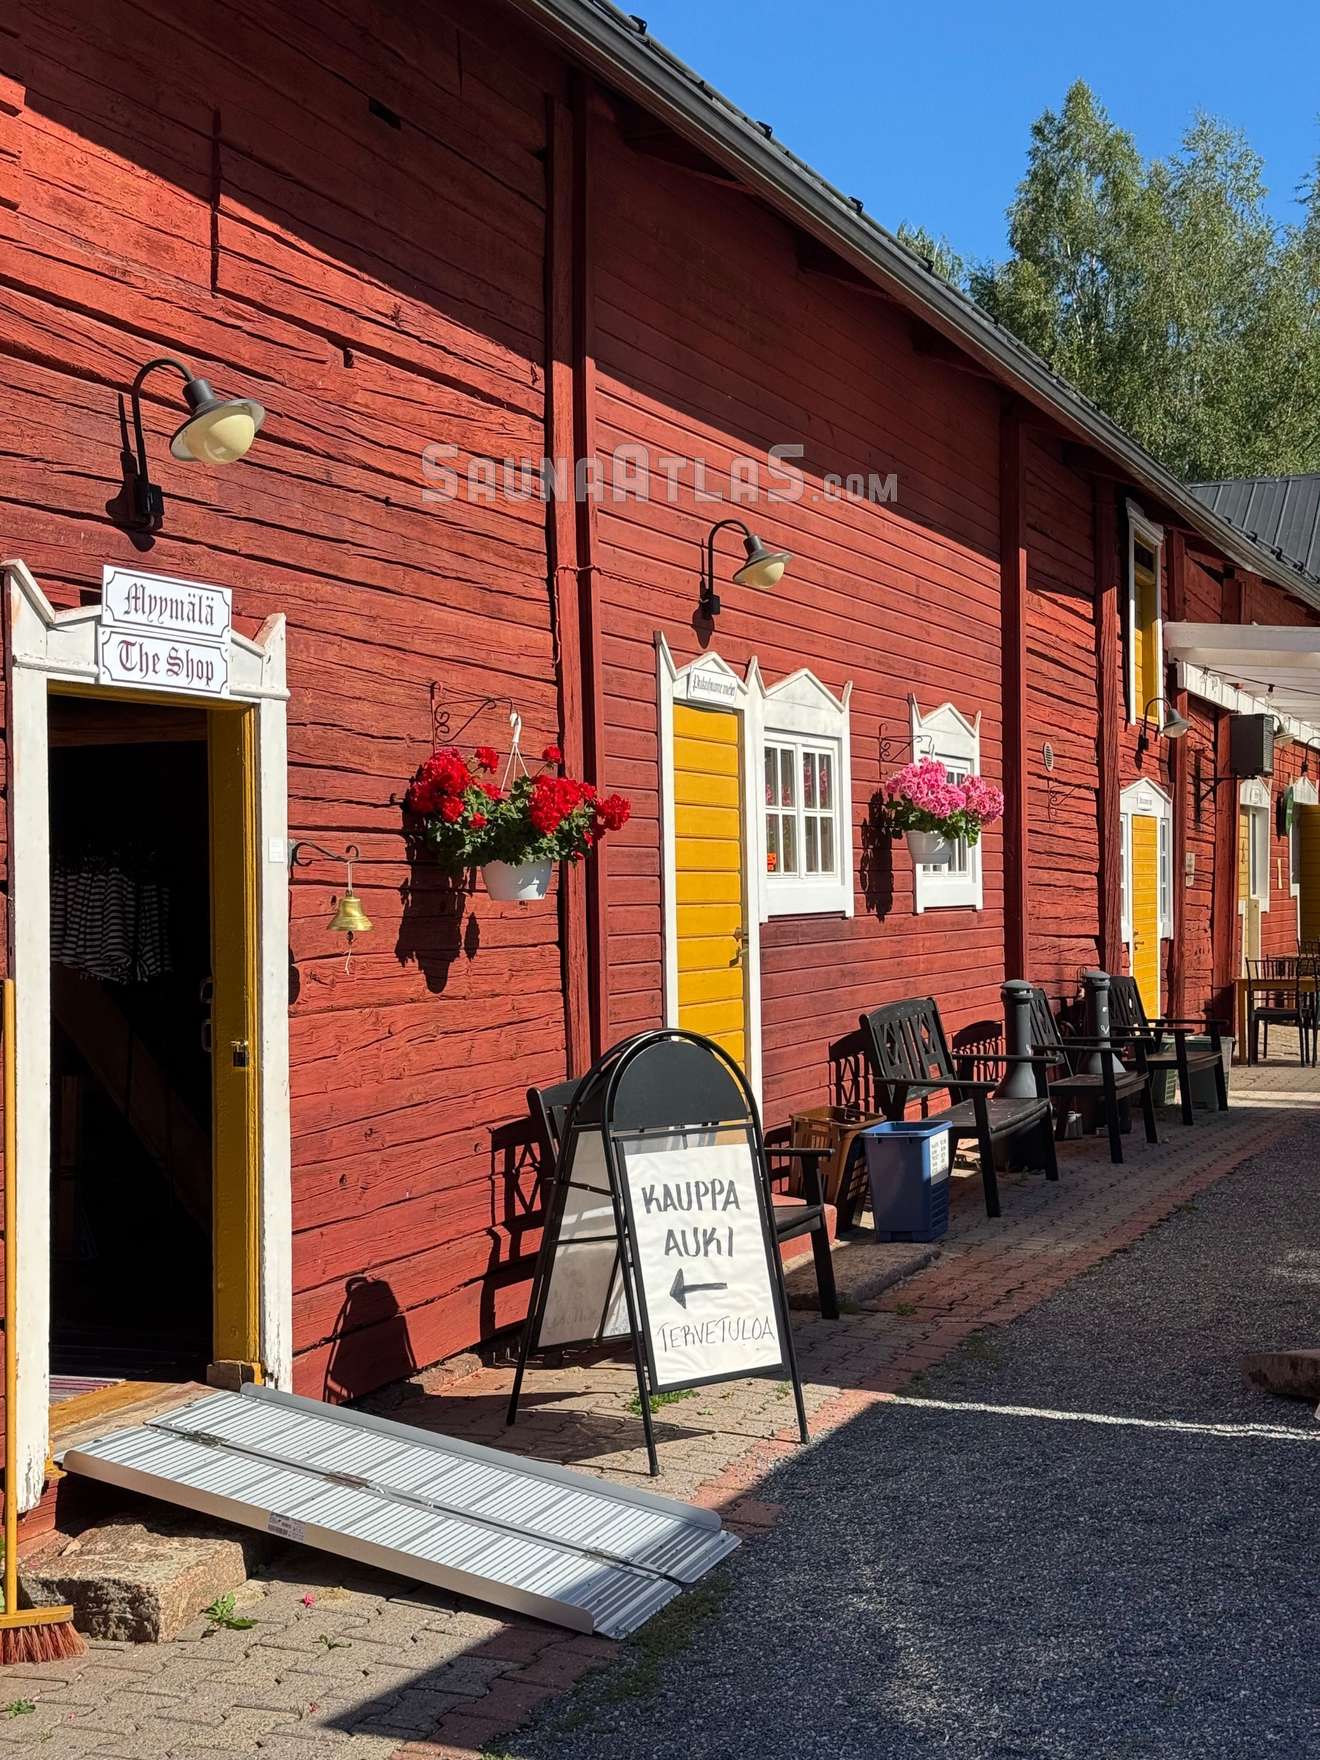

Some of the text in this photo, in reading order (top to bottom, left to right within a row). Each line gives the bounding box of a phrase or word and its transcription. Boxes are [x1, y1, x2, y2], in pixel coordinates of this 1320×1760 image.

[123, 582, 214, 626] Myymälä
[117, 639, 214, 688] The Shop
[641, 1178, 741, 1214] KAUPPA
[664, 1226, 734, 1257] AUKI
[656, 1315, 776, 1353] TERVETULOA
